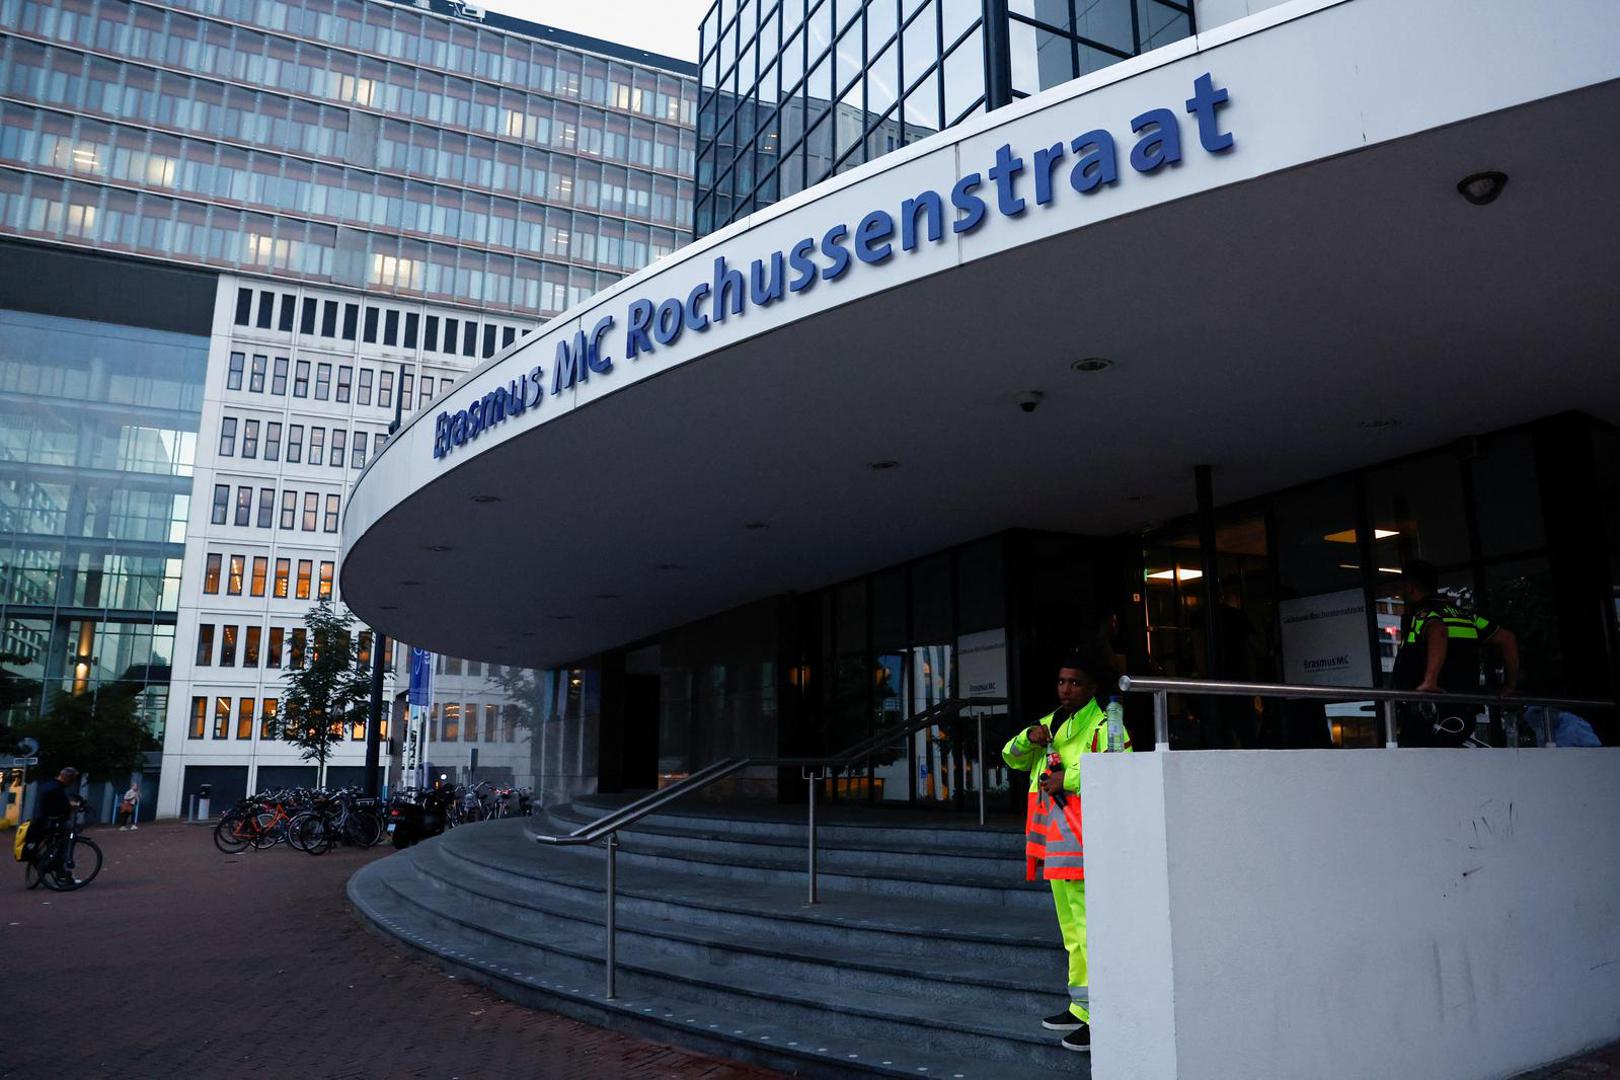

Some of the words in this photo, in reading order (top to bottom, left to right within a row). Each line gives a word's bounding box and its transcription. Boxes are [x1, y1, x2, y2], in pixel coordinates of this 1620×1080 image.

[434, 366, 544, 460] Erasmus
[551, 315, 615, 396] MC
[626, 72, 1237, 359] Rochussenstraat
